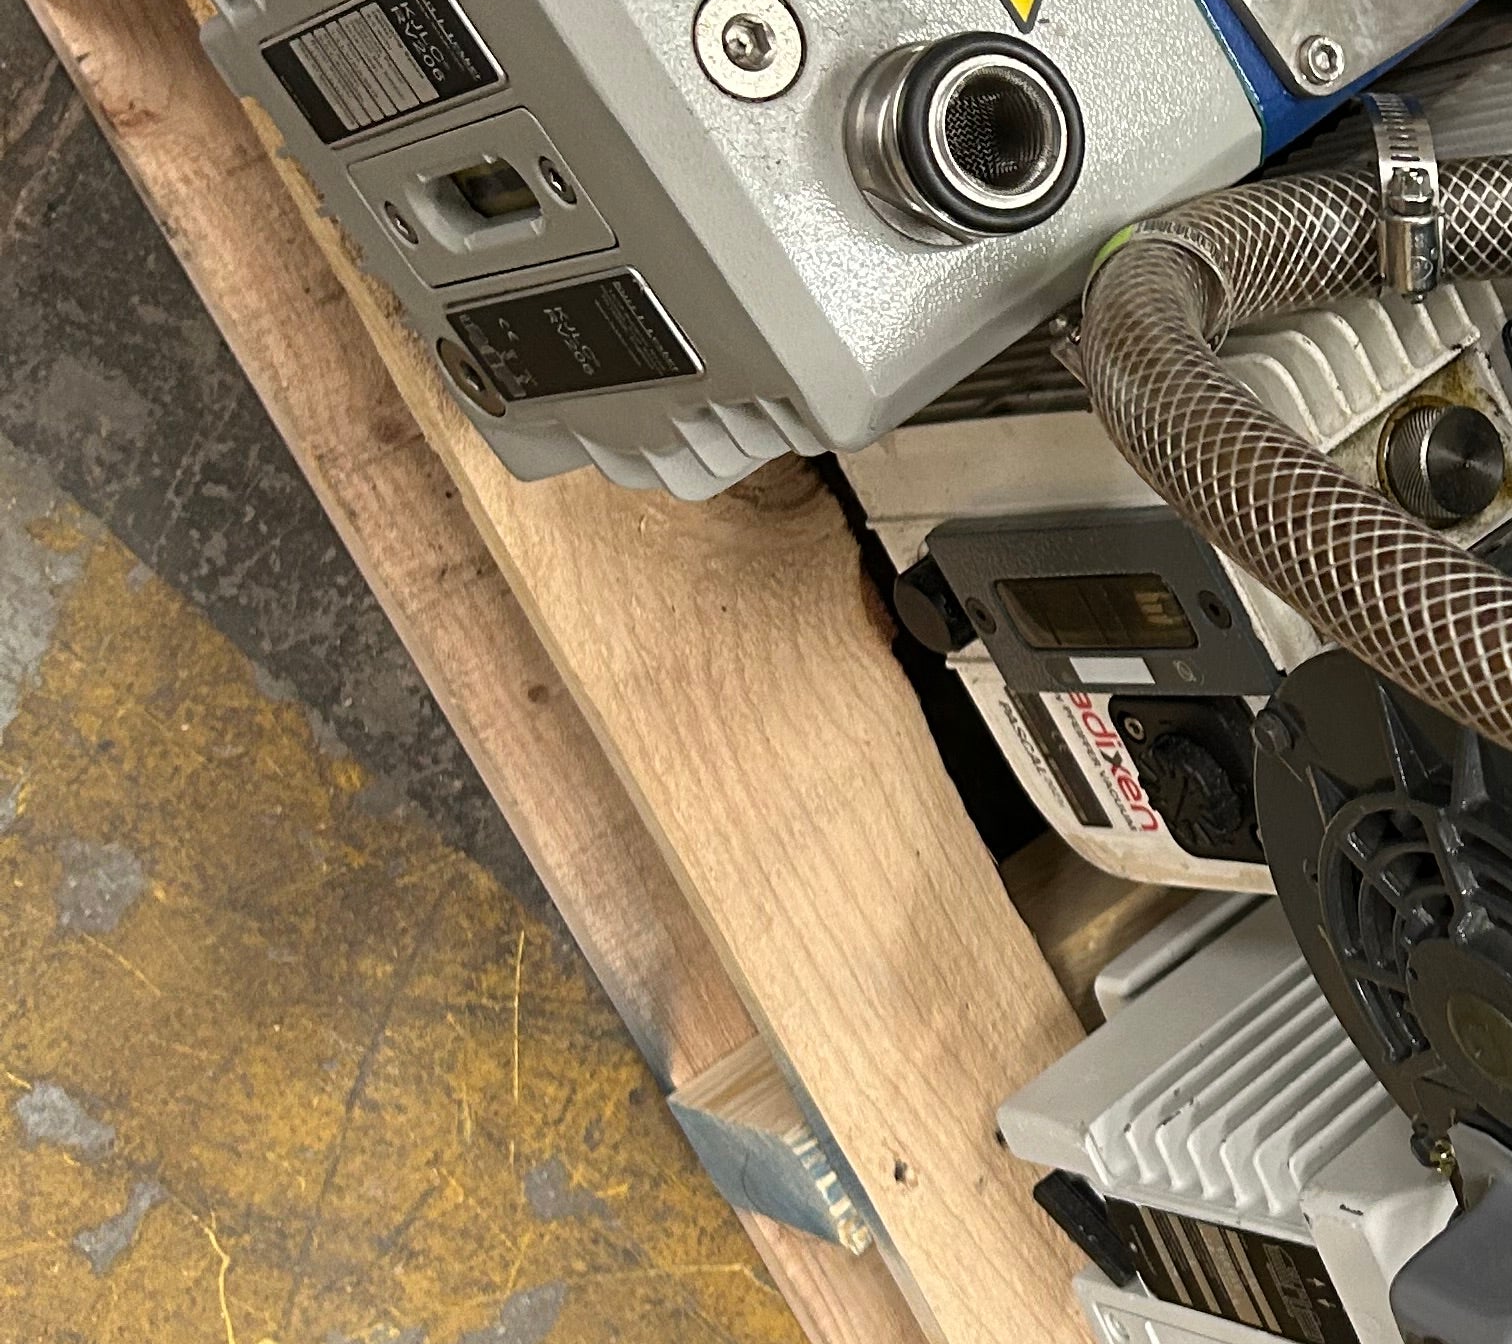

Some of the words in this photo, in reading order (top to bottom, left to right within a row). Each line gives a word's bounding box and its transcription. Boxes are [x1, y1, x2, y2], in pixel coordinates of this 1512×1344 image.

[390, 3, 445, 84] RV206
[997, 697, 1048, 777] PASCAL
[1059, 702, 1103, 768] PFEIFFER
[1097, 768, 1139, 834] VACUUM
[1066, 691, 1158, 832] adixen
